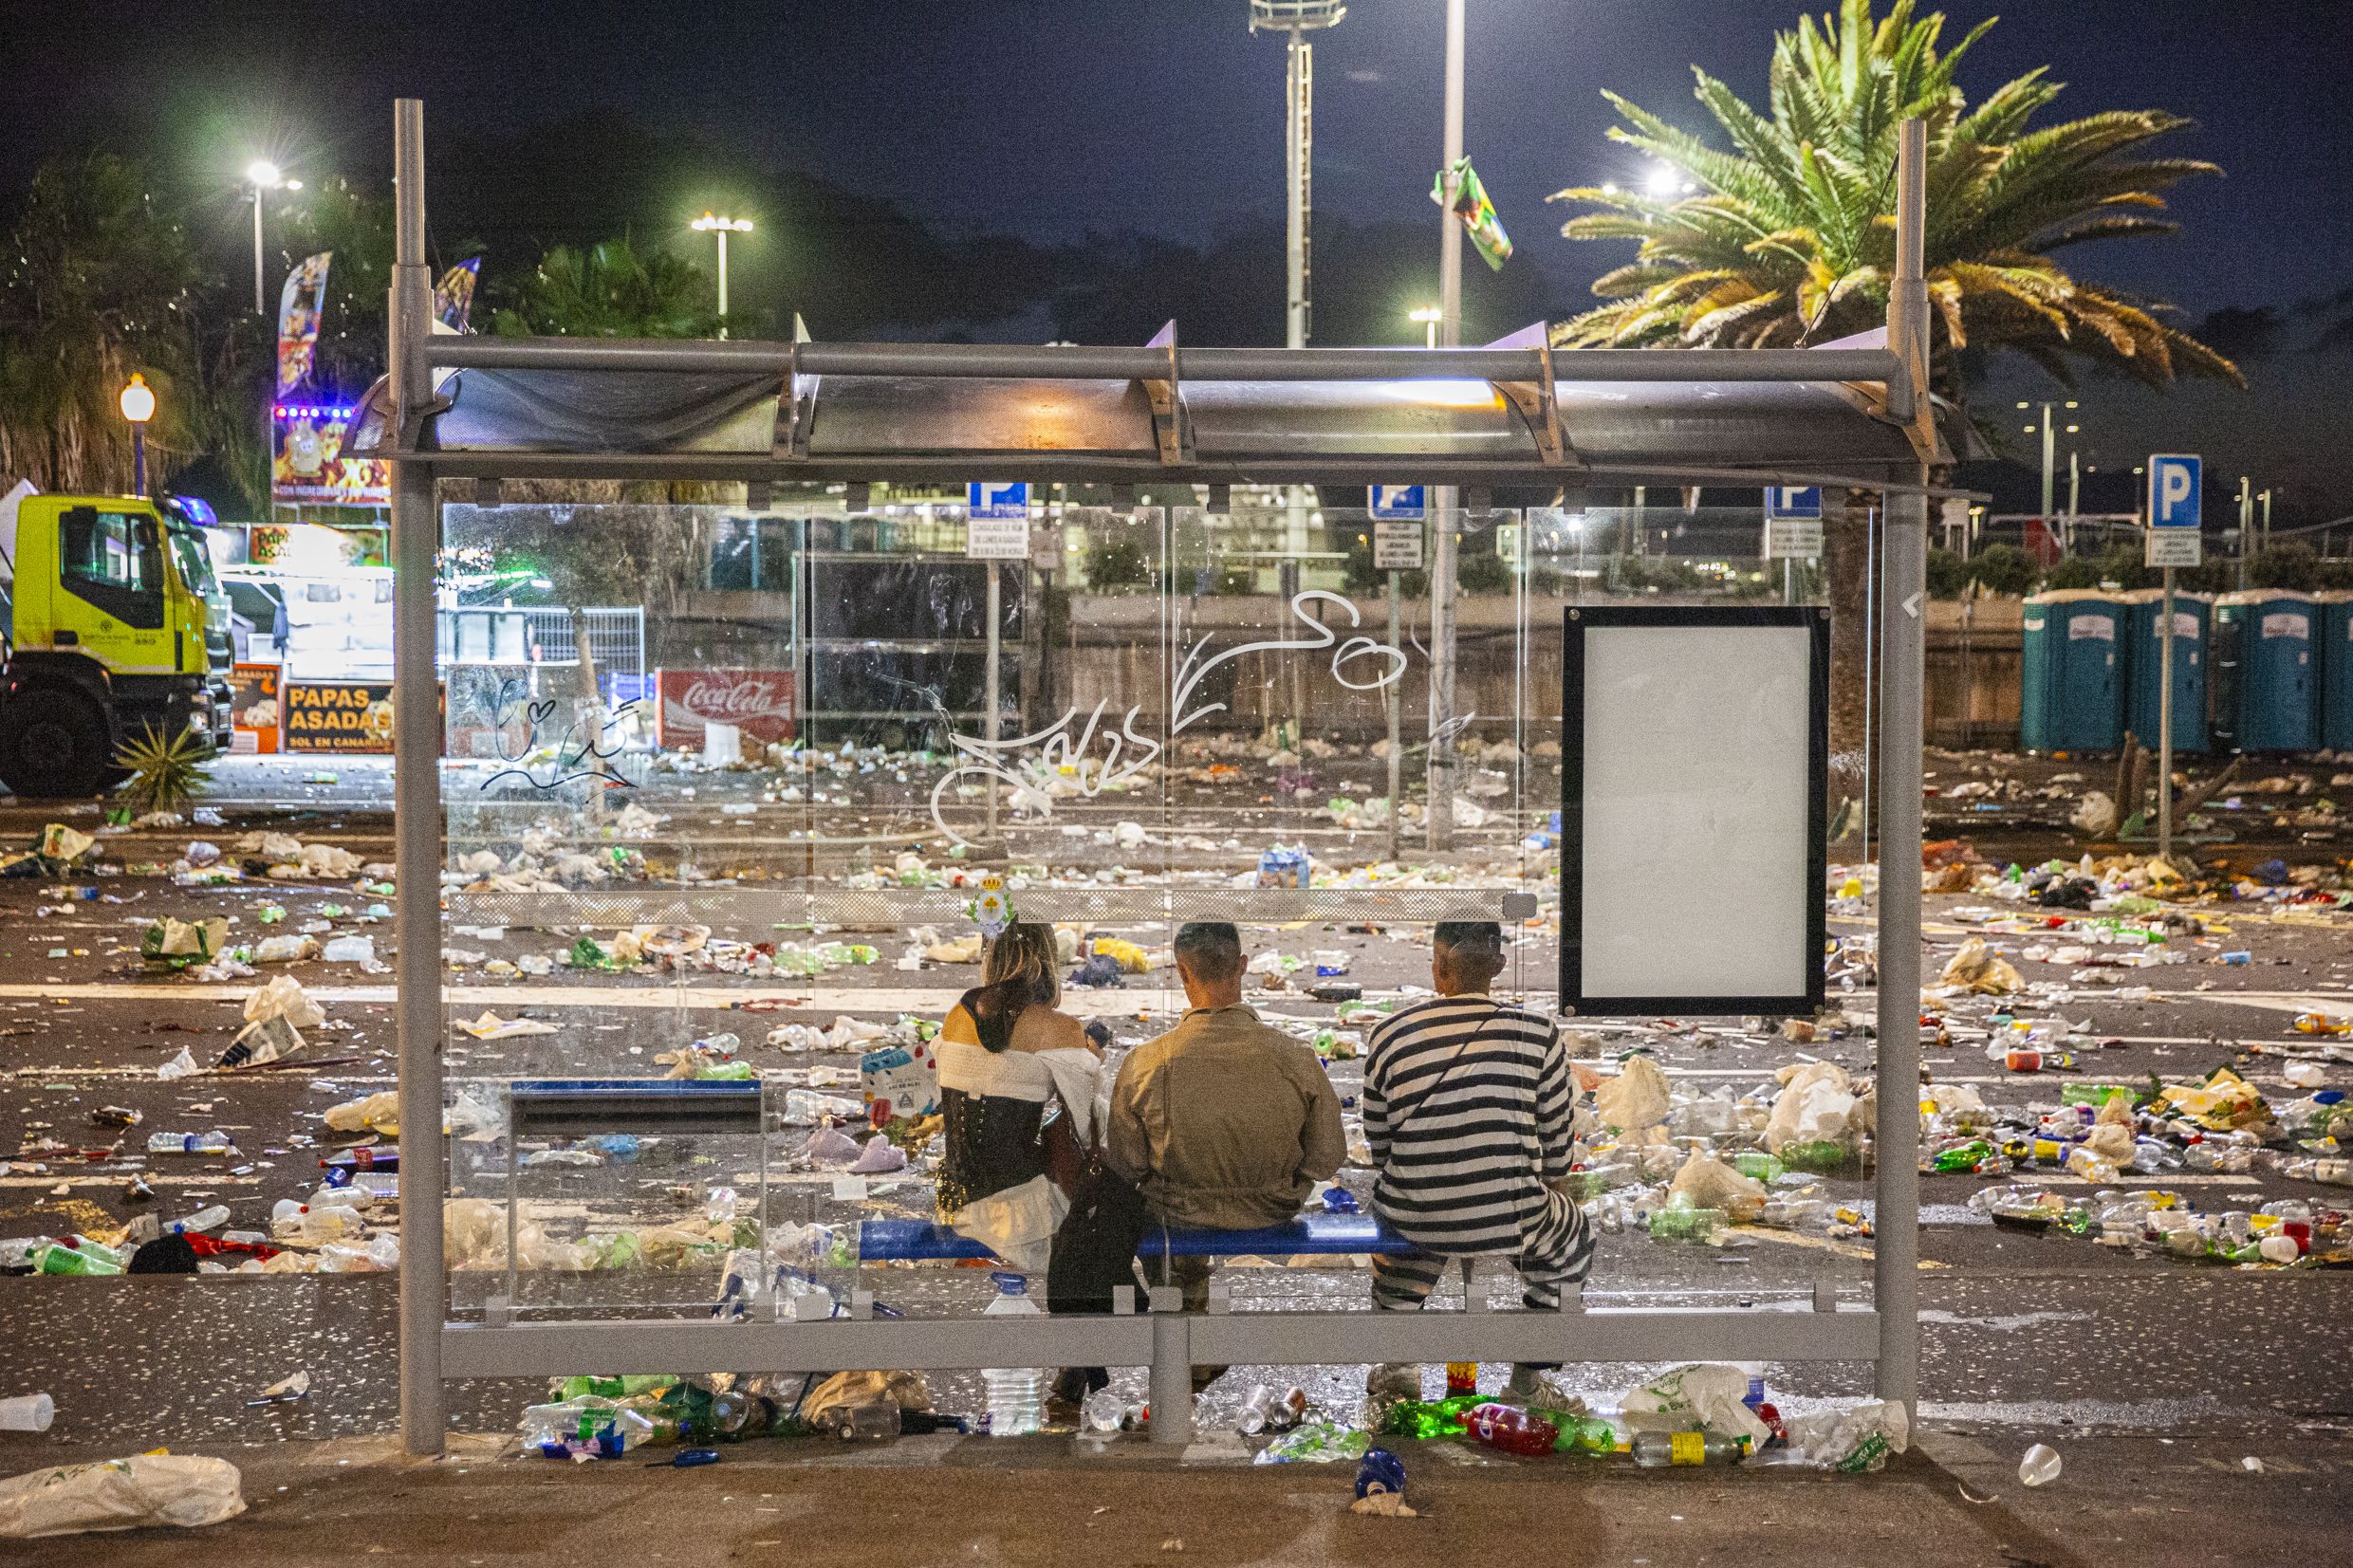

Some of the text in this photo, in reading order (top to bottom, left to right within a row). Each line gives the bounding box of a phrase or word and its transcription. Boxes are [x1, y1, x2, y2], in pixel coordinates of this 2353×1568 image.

[2162, 464, 2192, 521] P
[288, 688, 370, 708] PAPAS
[288, 710, 391, 729] ASADAS
[288, 737, 312, 747] SOL
[314, 737, 332, 747] EN
